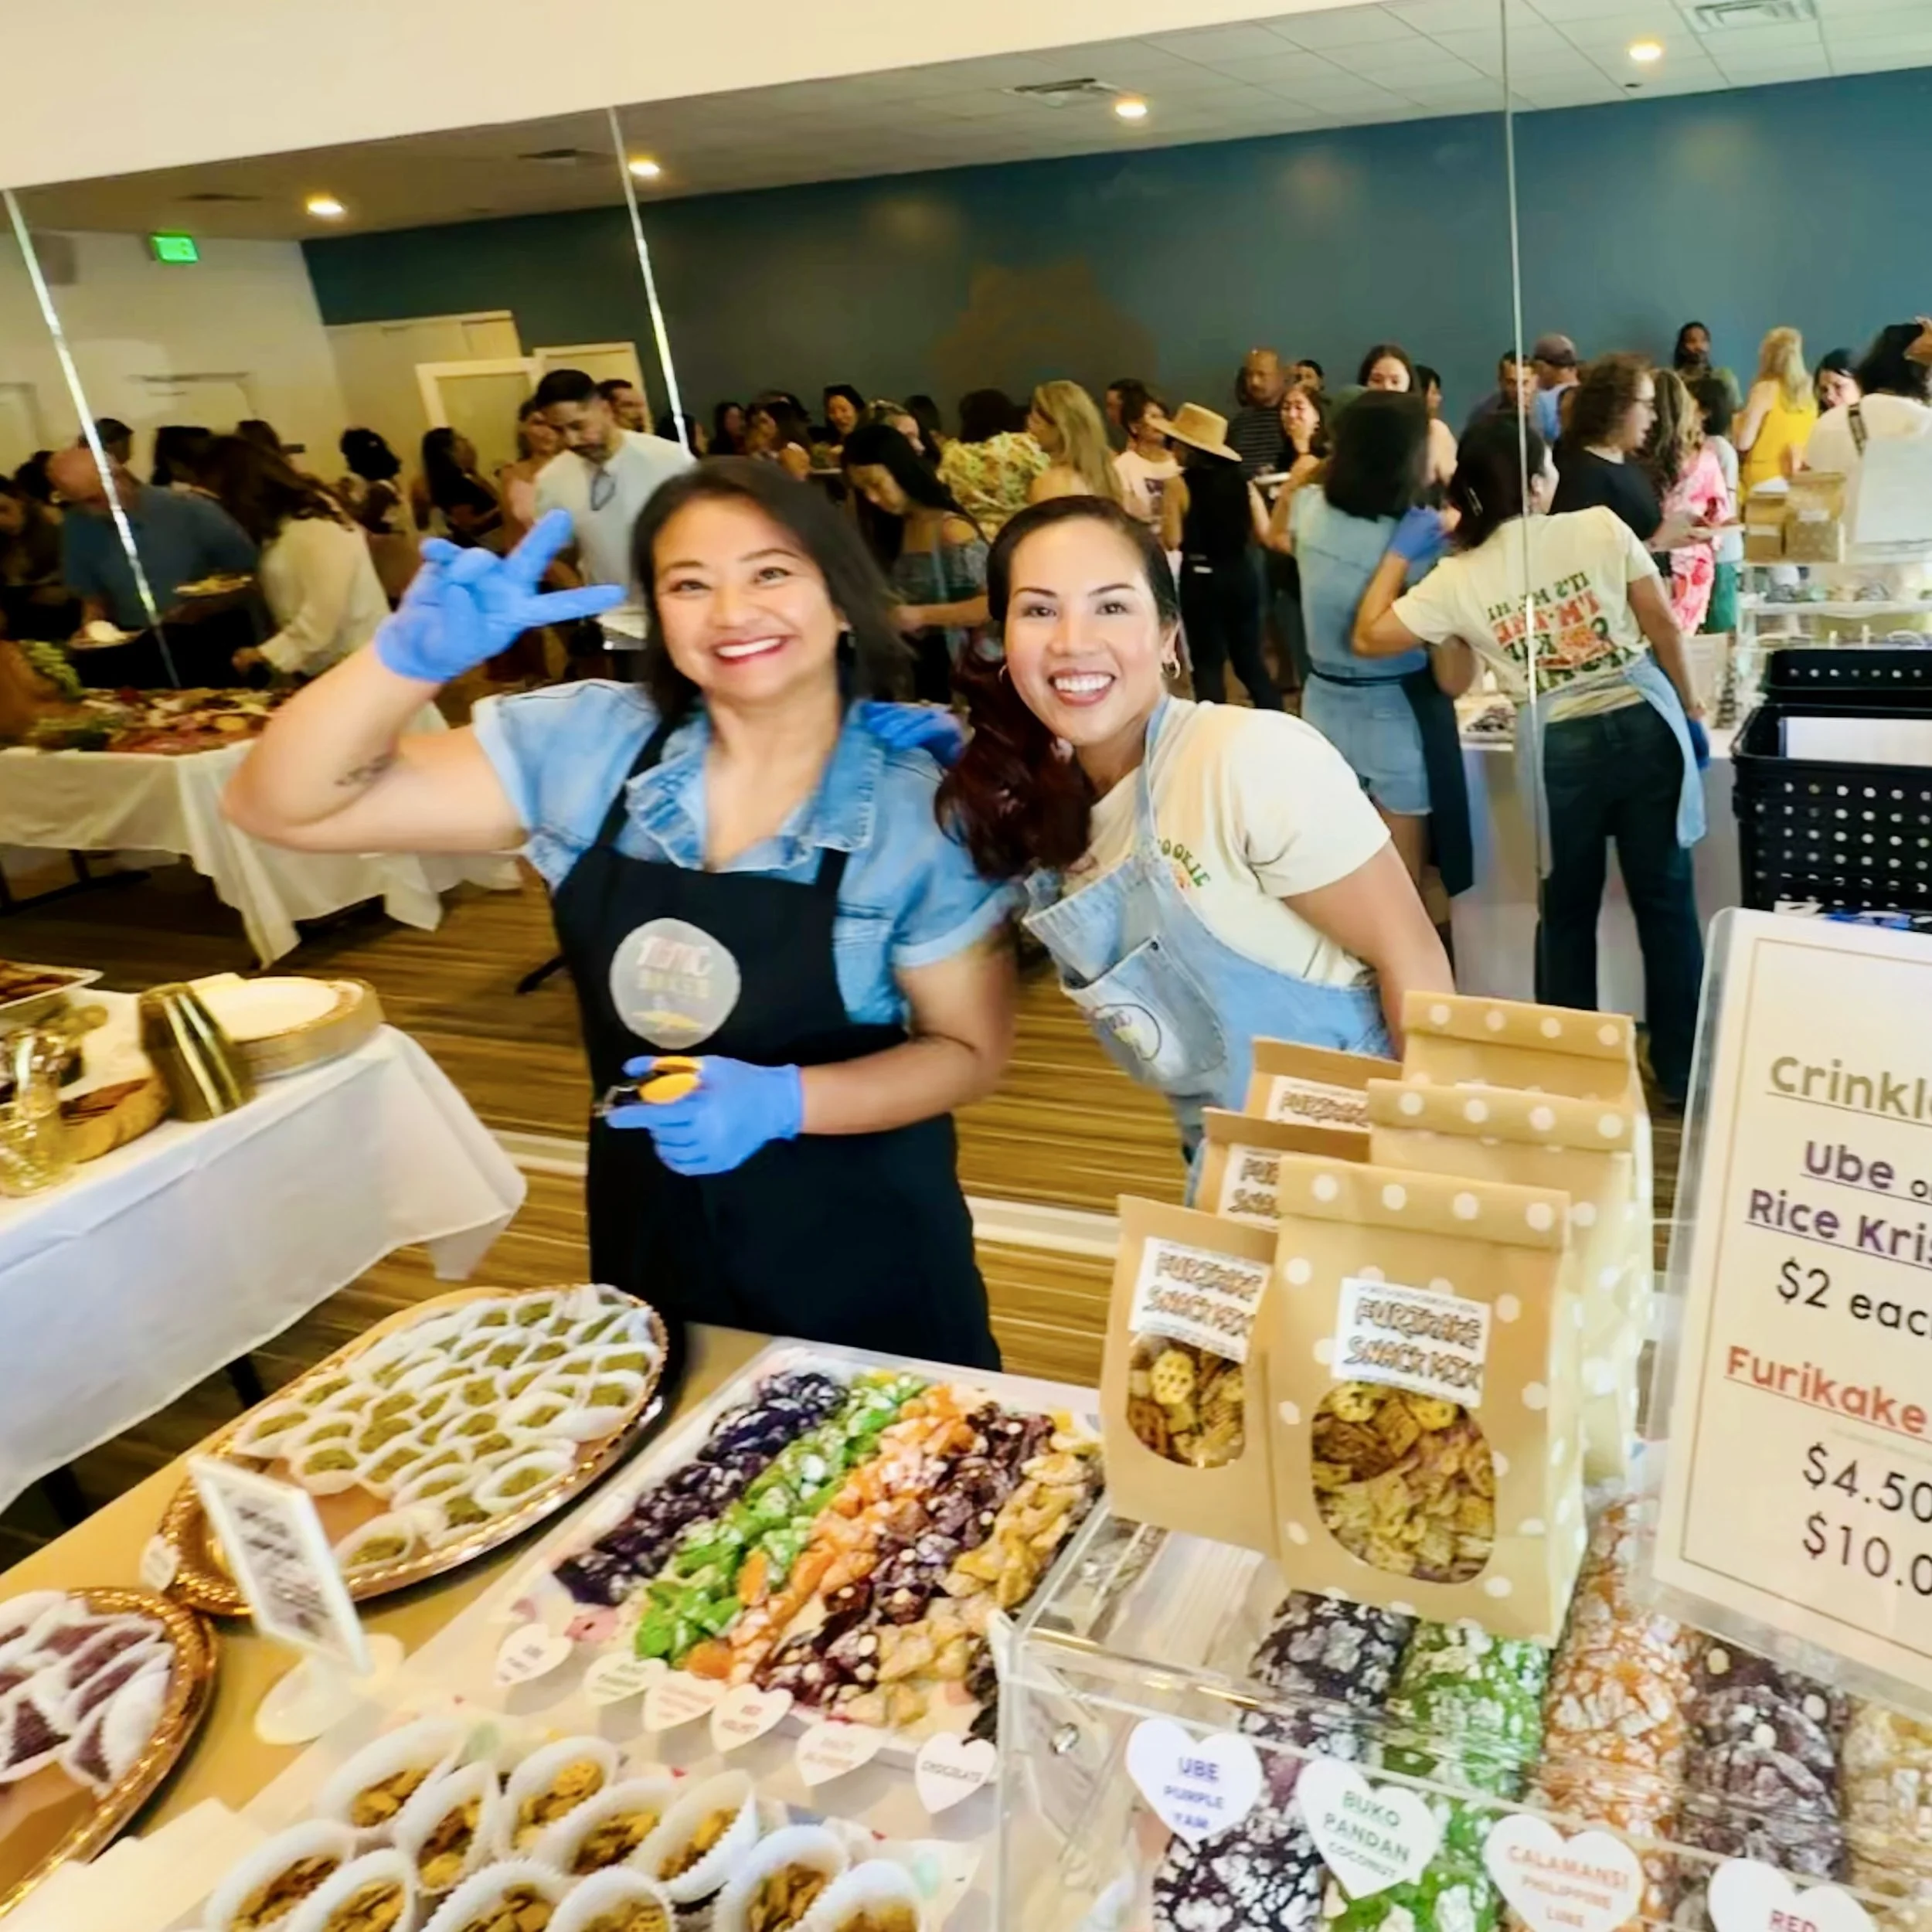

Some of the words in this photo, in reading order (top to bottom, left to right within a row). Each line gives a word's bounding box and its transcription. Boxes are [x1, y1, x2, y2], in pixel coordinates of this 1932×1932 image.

[1770, 1056, 1932, 1119] Crinkl
[1804, 1140, 1895, 1189] Ube
[1910, 1179, 1932, 1200] o
[1748, 1188, 1841, 1239] Rice
[1856, 1214, 1932, 1264] Kri
[1776, 1256, 1832, 1309] $2
[1849, 1293, 1932, 1339] eac
[1726, 1345, 1927, 1434] Furikake
[1802, 1441, 1932, 1524] $4.50
[1163, 1785, 1225, 1809] PURPLE
[1178, 1757, 1219, 1783] UBE
[1324, 1812, 1410, 1862] PANDAN
[1343, 1790, 1401, 1827] BUKO
[1506, 1845, 1629, 1893] CALAMANSI
